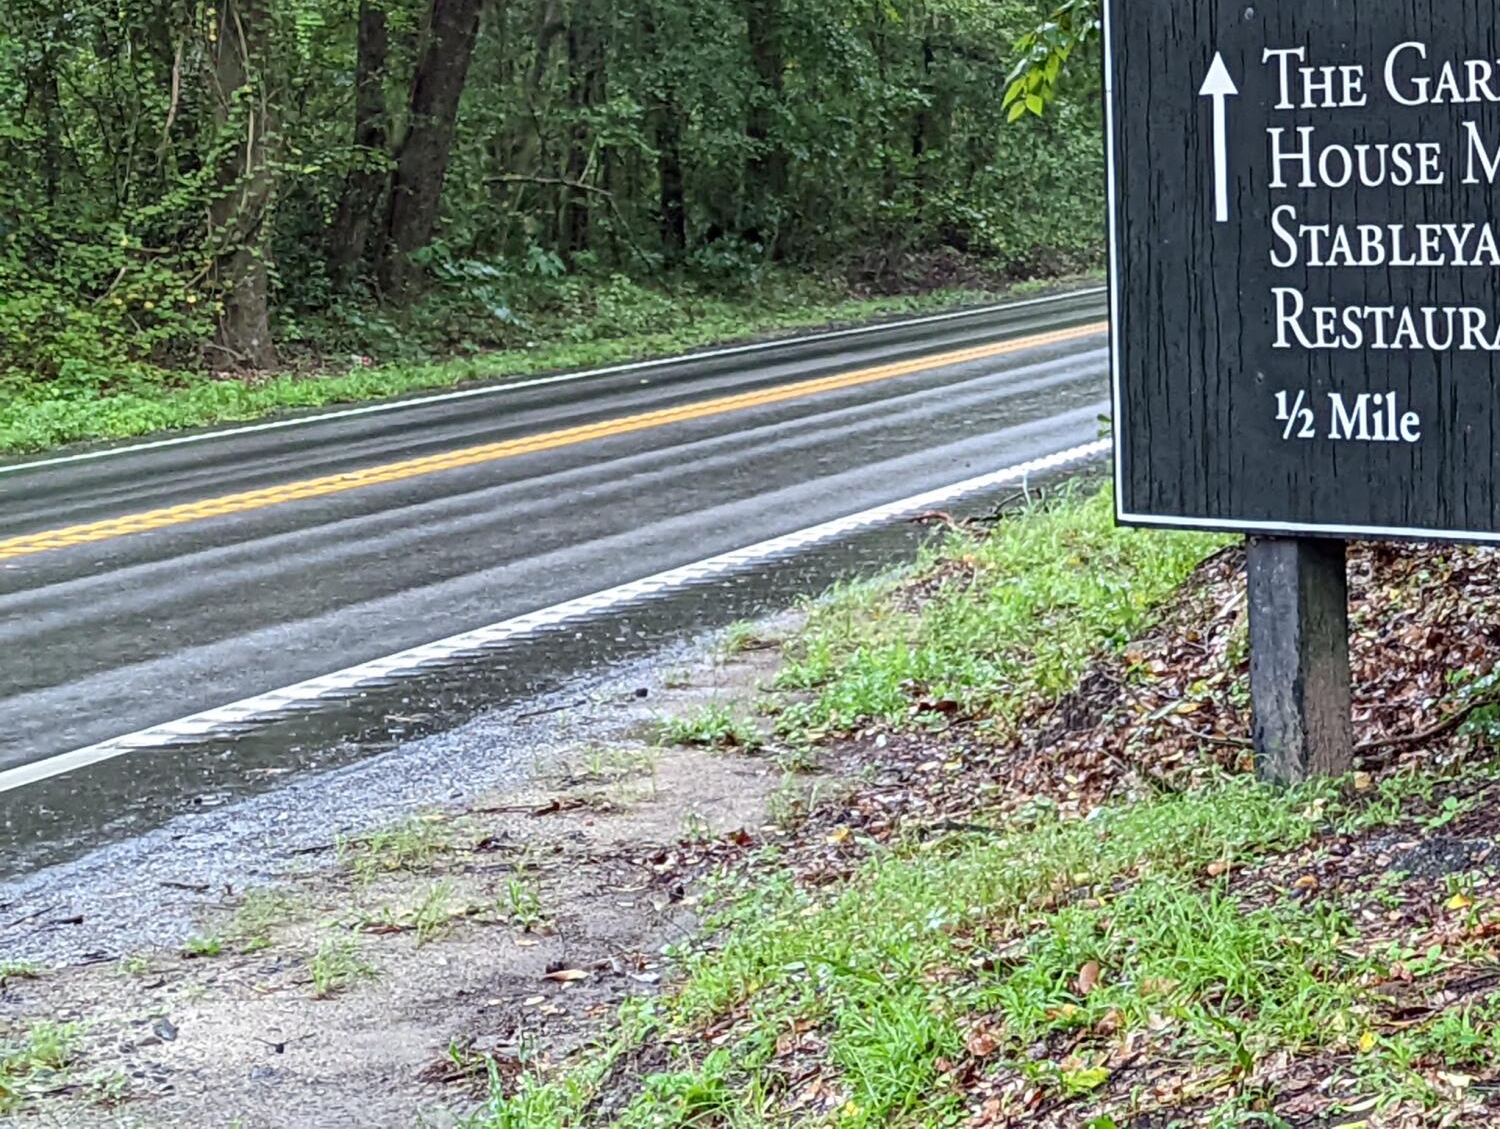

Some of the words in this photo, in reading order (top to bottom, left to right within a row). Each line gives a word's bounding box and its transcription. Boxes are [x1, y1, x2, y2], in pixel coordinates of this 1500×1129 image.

[1260, 45, 1368, 111] THE
[1266, 125, 1445, 189] HOUSE
[1326, 389, 1422, 444] Mile
